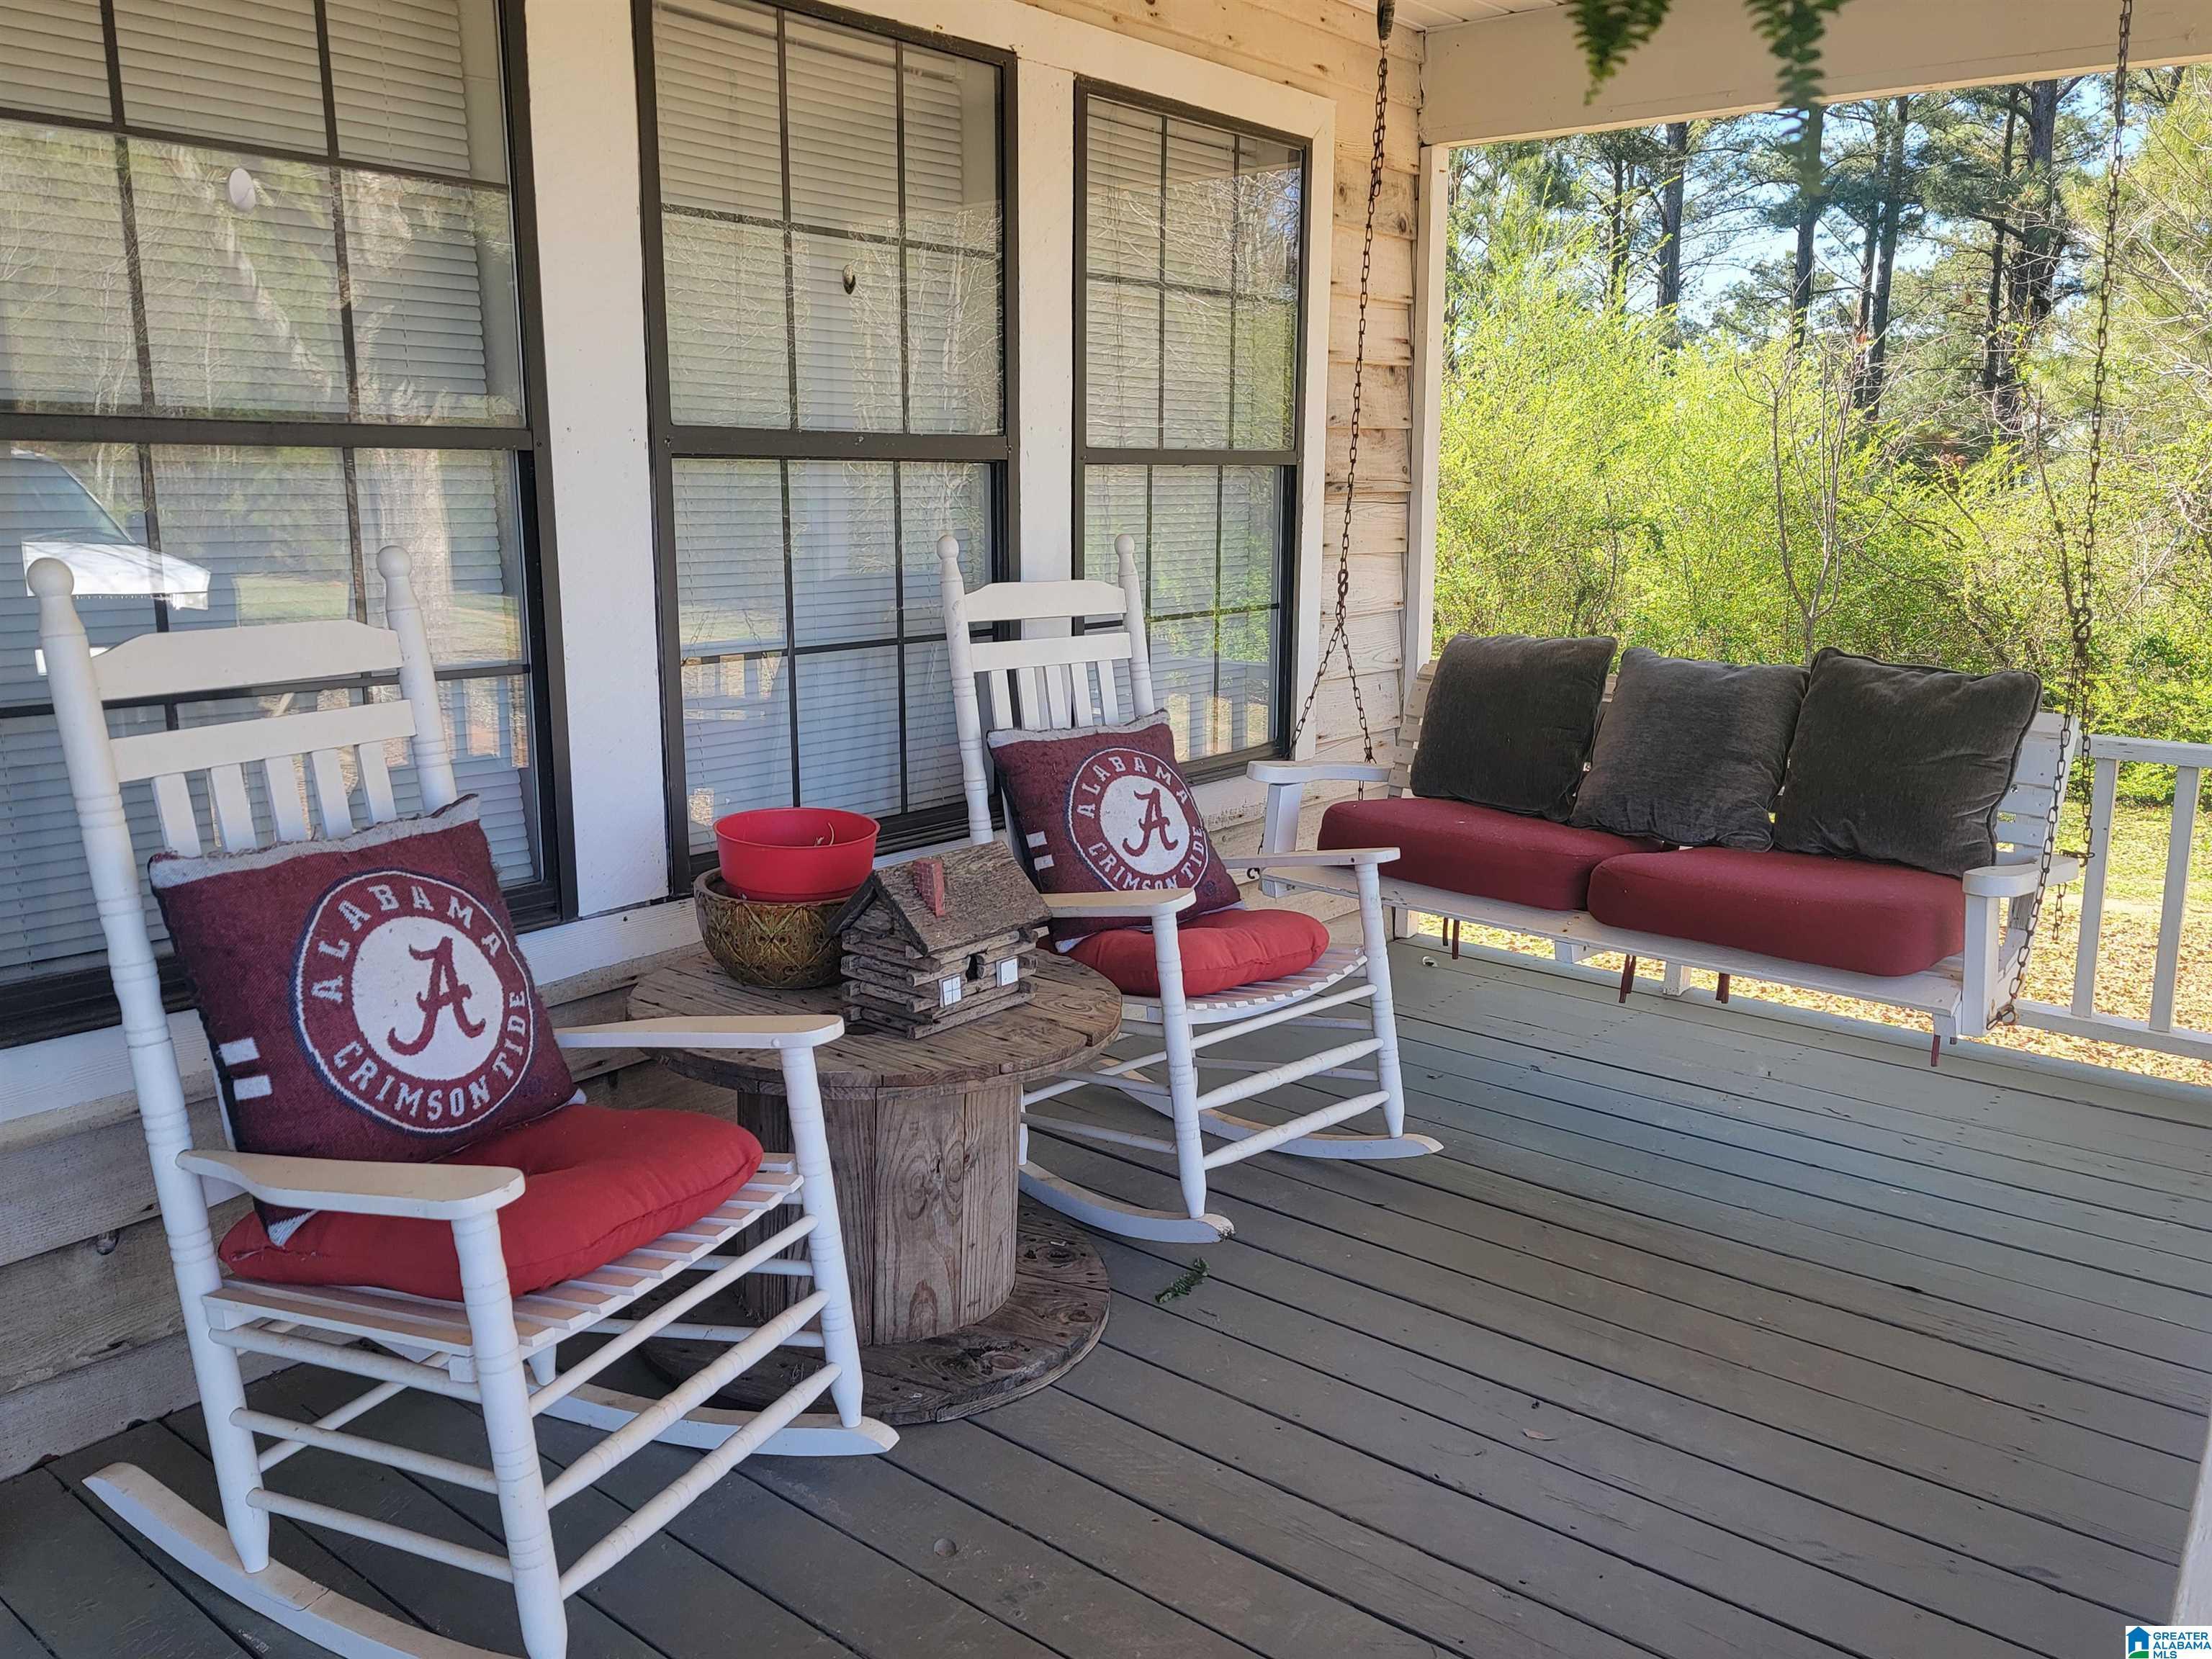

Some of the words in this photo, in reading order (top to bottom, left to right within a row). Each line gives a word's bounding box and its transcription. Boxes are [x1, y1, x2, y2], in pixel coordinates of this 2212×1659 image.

[1077, 756, 1188, 819] ALABAMA
[1123, 787, 1178, 856] A
[1181, 827, 1204, 881] TIDE
[311, 884, 501, 1003] ALABAMA
[387, 936, 485, 1056] A
[333, 1040, 490, 1120] CRIMSON
[492, 991, 526, 1079] TIDE
